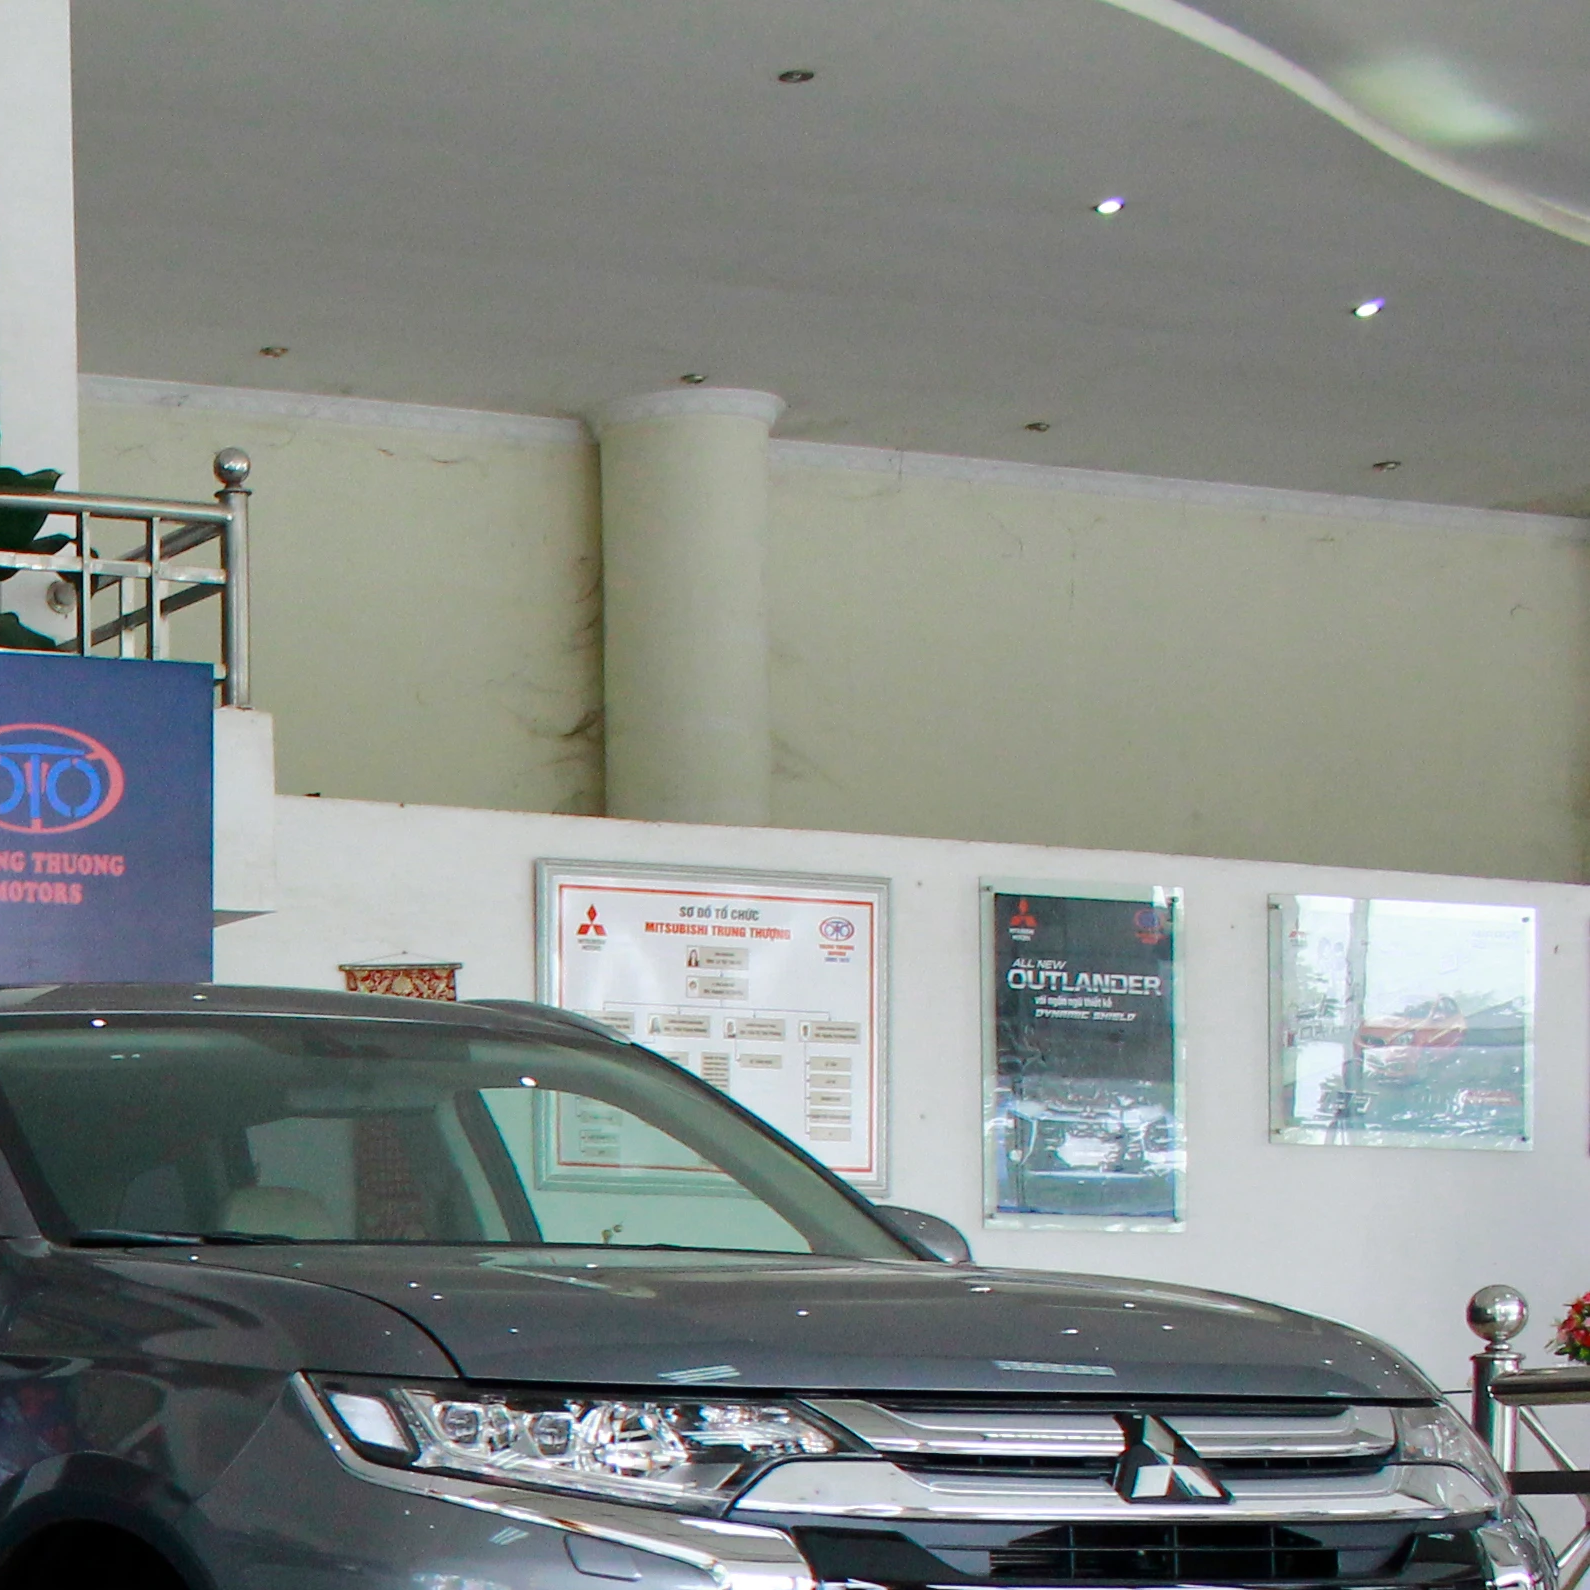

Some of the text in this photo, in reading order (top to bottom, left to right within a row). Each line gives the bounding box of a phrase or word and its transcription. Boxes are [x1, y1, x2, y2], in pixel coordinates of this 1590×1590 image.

[31, 851, 126, 877] THUONG
[645, 921, 708, 936] MITSUBISHI
[712, 925, 746, 938] TRUNG
[1012, 957, 1067, 970] ALL NEW
[1007, 968, 1162, 996] OUTLANDER
